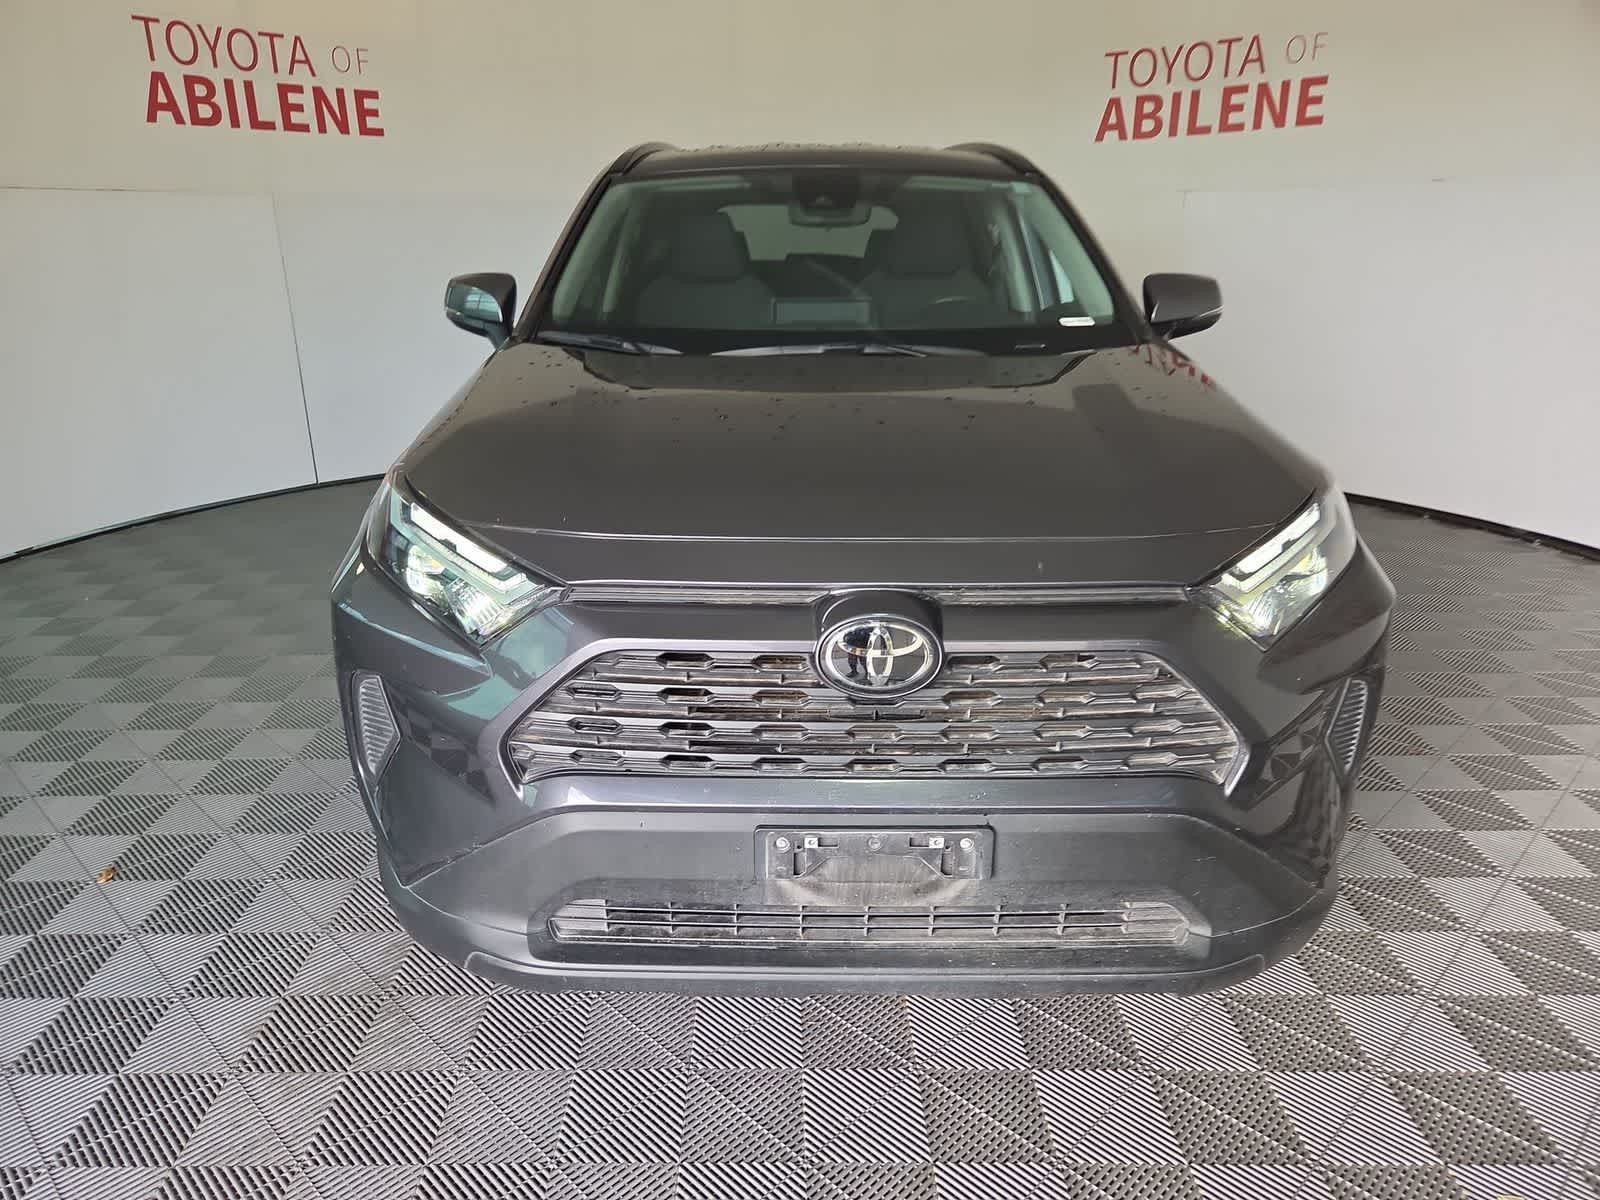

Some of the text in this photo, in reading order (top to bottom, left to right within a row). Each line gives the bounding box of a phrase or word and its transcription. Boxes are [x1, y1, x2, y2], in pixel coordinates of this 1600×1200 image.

[131, 15, 369, 77] TOYOTA OF
[1104, 32, 1328, 89] TOYOTA OF
[146, 71, 385, 137] ABILENE
[1094, 74, 1329, 143] ABILENE
